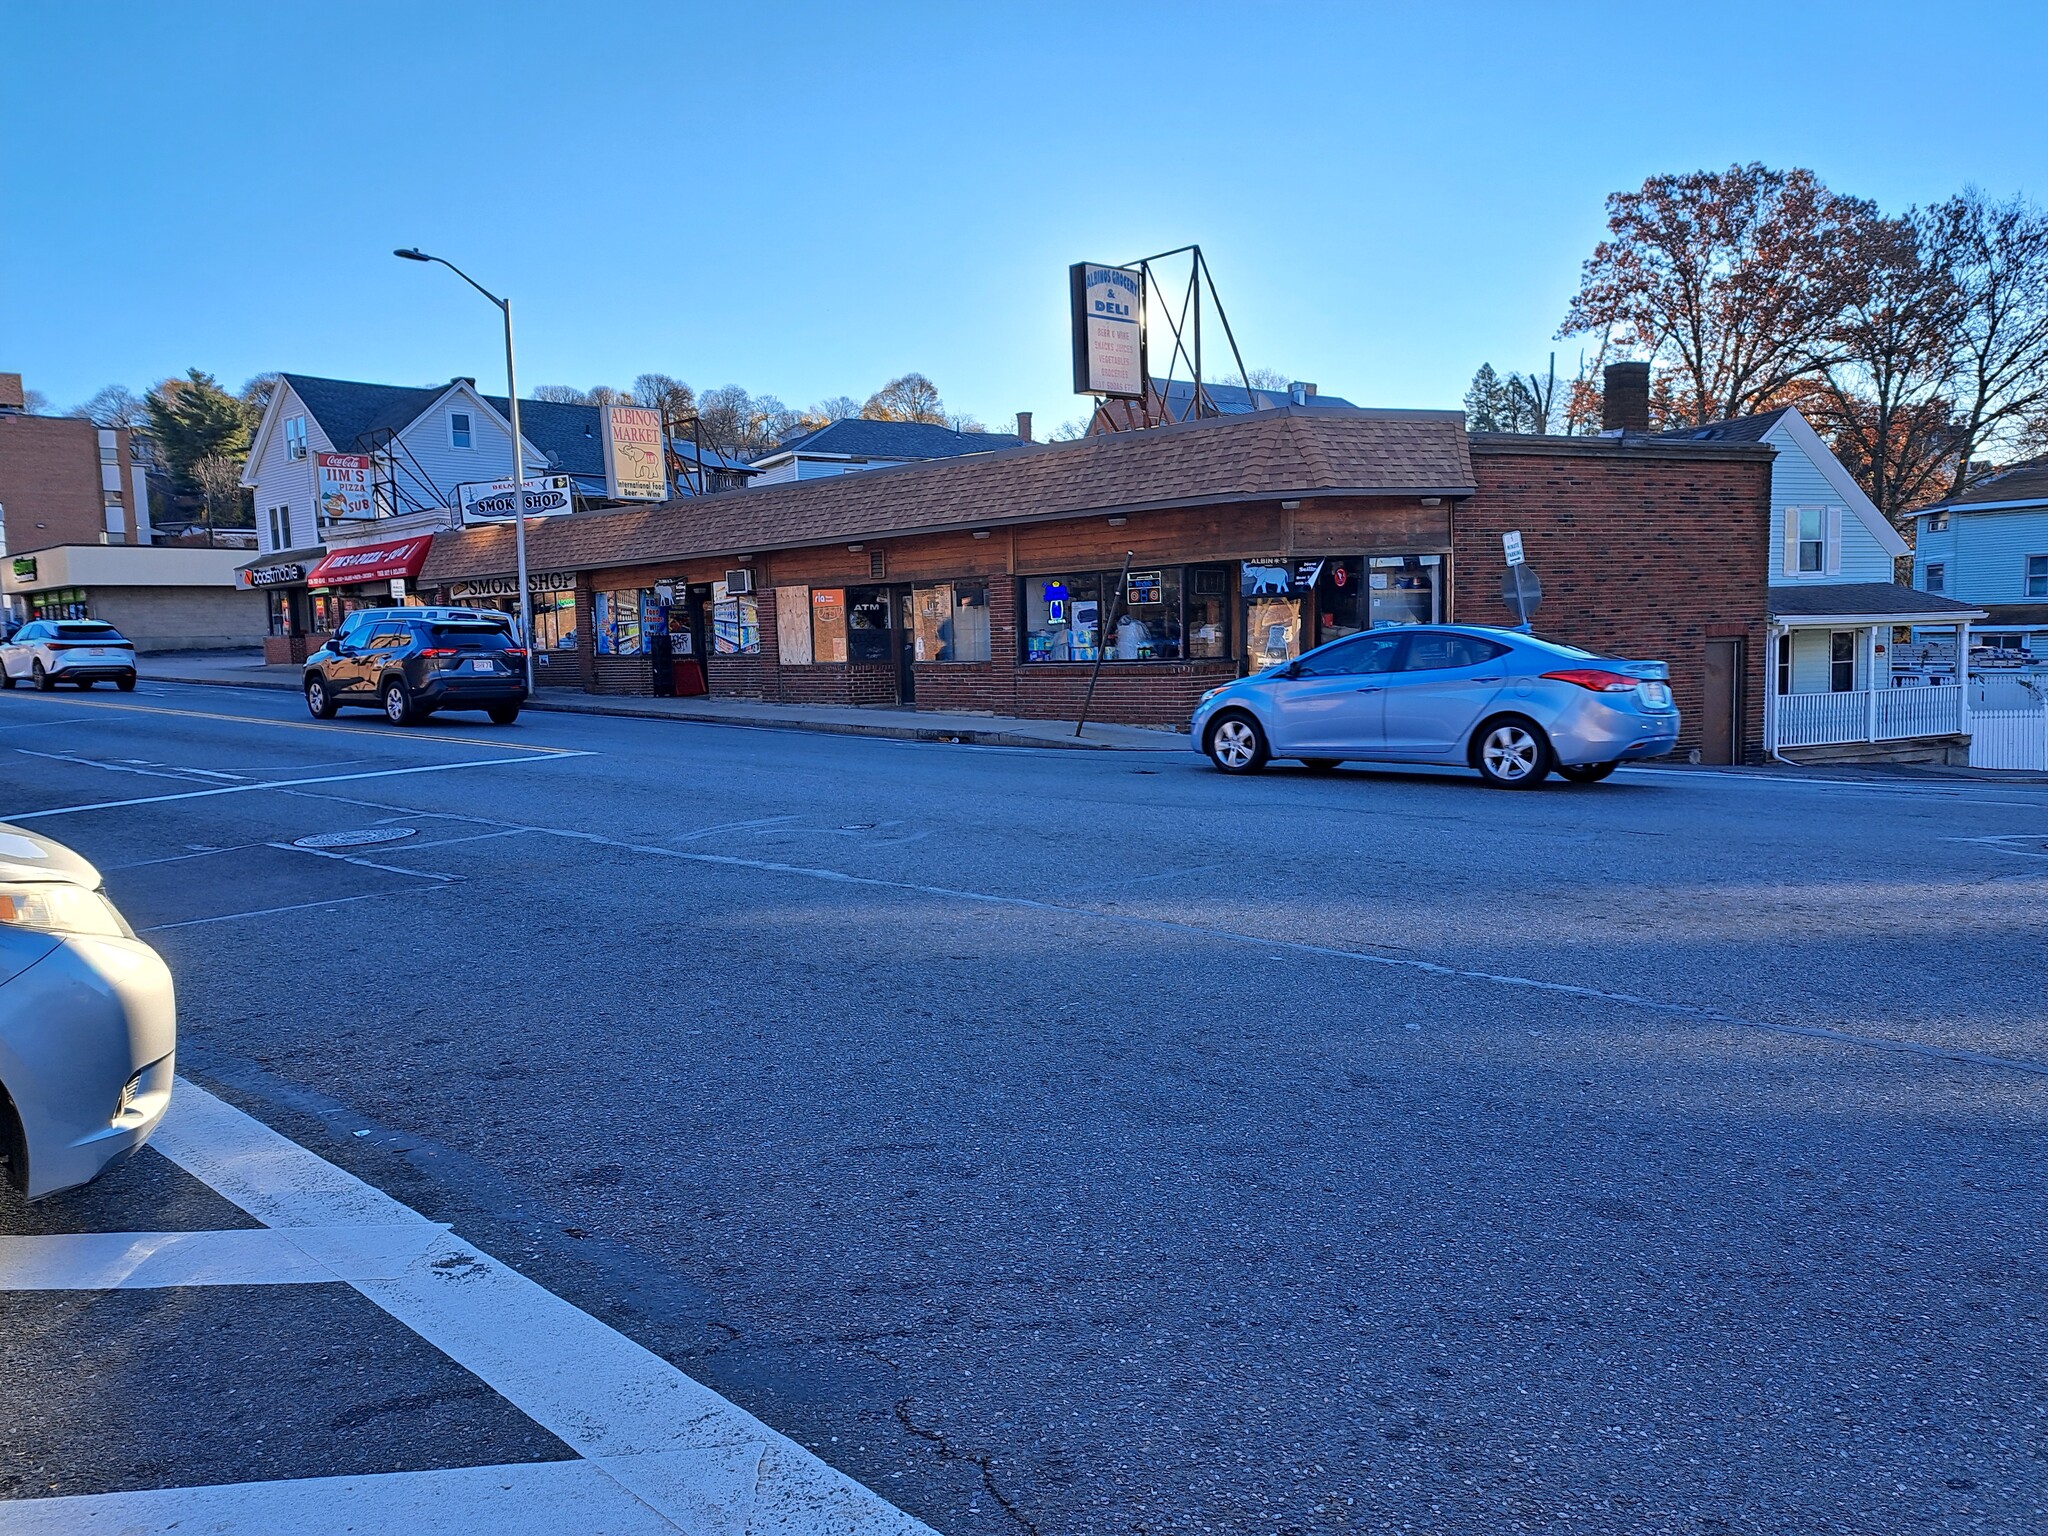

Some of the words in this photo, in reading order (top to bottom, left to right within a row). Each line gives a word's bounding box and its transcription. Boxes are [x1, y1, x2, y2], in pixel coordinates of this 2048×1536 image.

[1086, 269, 1111, 289] ALBINOS
[1111, 270, 1138, 297] GROCERY
[1107, 288, 1116, 299] &
[1094, 300, 1130, 316] DELI
[1098, 354, 1130, 366] VEGETABLES
[1101, 367, 1129, 379] GROCERIES
[611, 409, 660, 427] ALBINO'S
[613, 427, 659, 442] MARKET
[327, 469, 365, 482] JIM'S
[339, 483, 365, 492] PIZZA
[492, 482, 534, 490] BELMNT
[617, 480, 652, 489] International
[348, 499, 370, 513] SUB
[478, 498, 516, 513] SMOK
[525, 494, 560, 508] SHOP
[815, 592, 826, 603] ria
